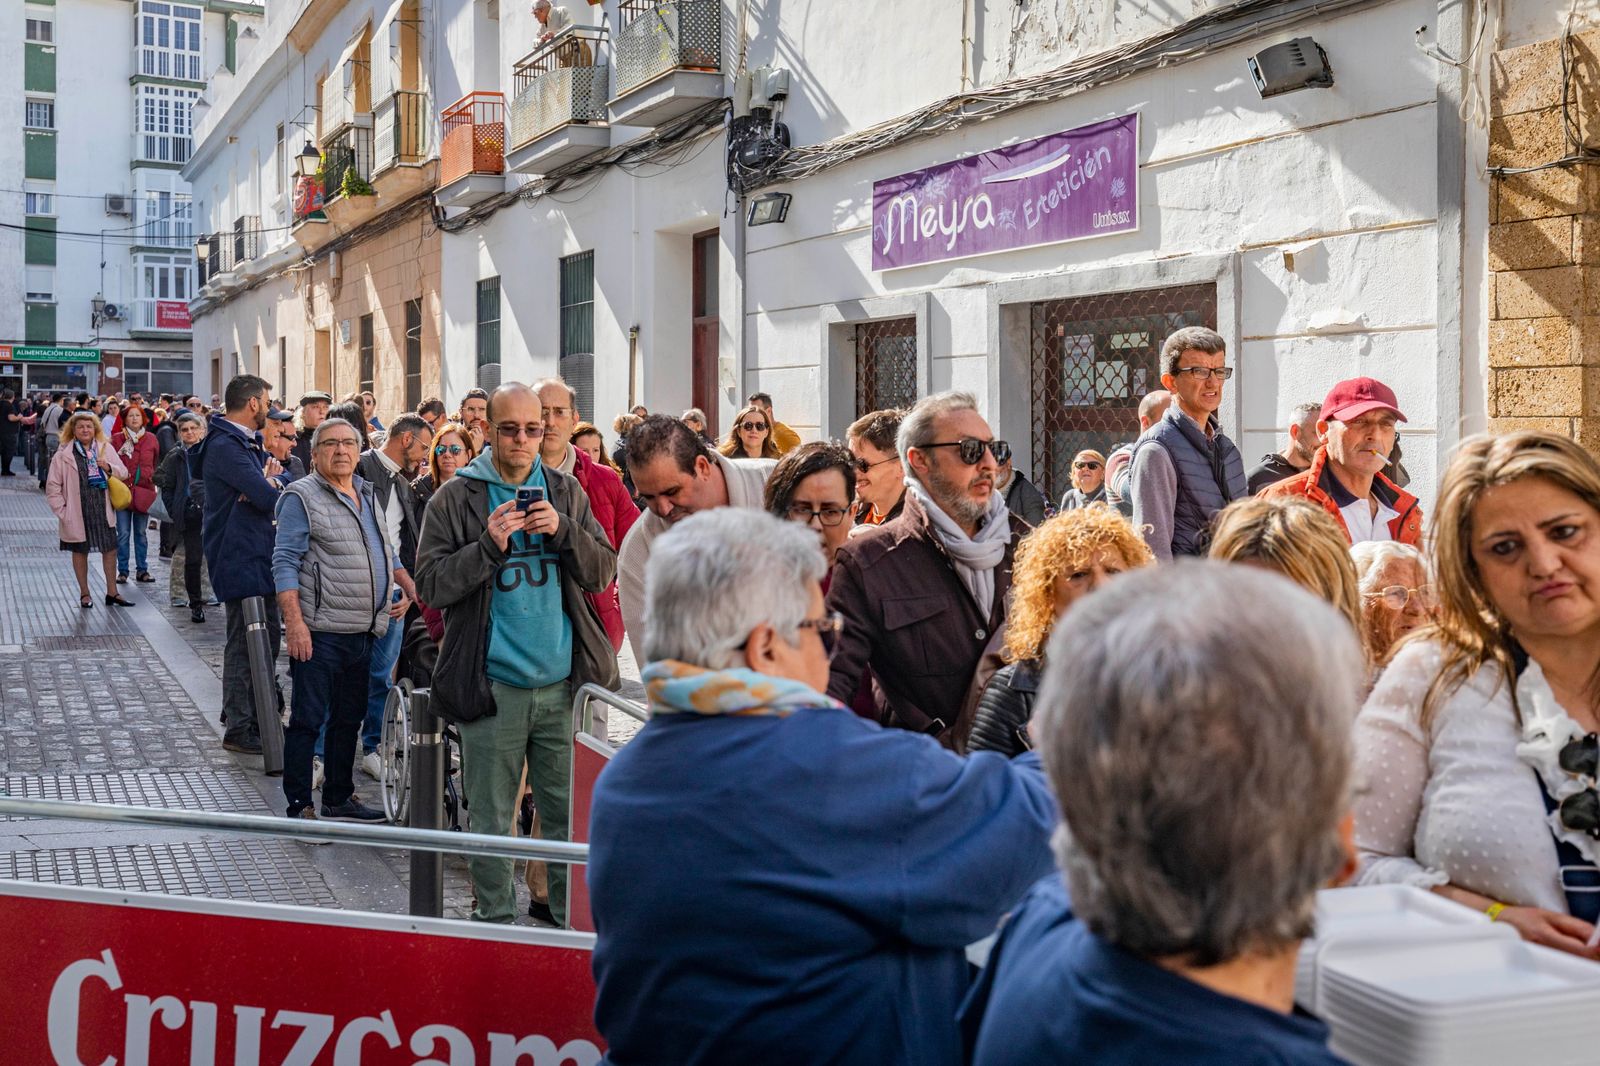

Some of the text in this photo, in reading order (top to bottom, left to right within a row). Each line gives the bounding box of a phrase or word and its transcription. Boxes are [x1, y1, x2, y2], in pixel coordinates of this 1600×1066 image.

[882, 146, 1111, 256] Meysa Esteticién
[1093, 210, 1130, 228] Unisex
[16, 348, 64, 357] ALIMENTACIÓN
[64, 350, 96, 358] EDUARDO
